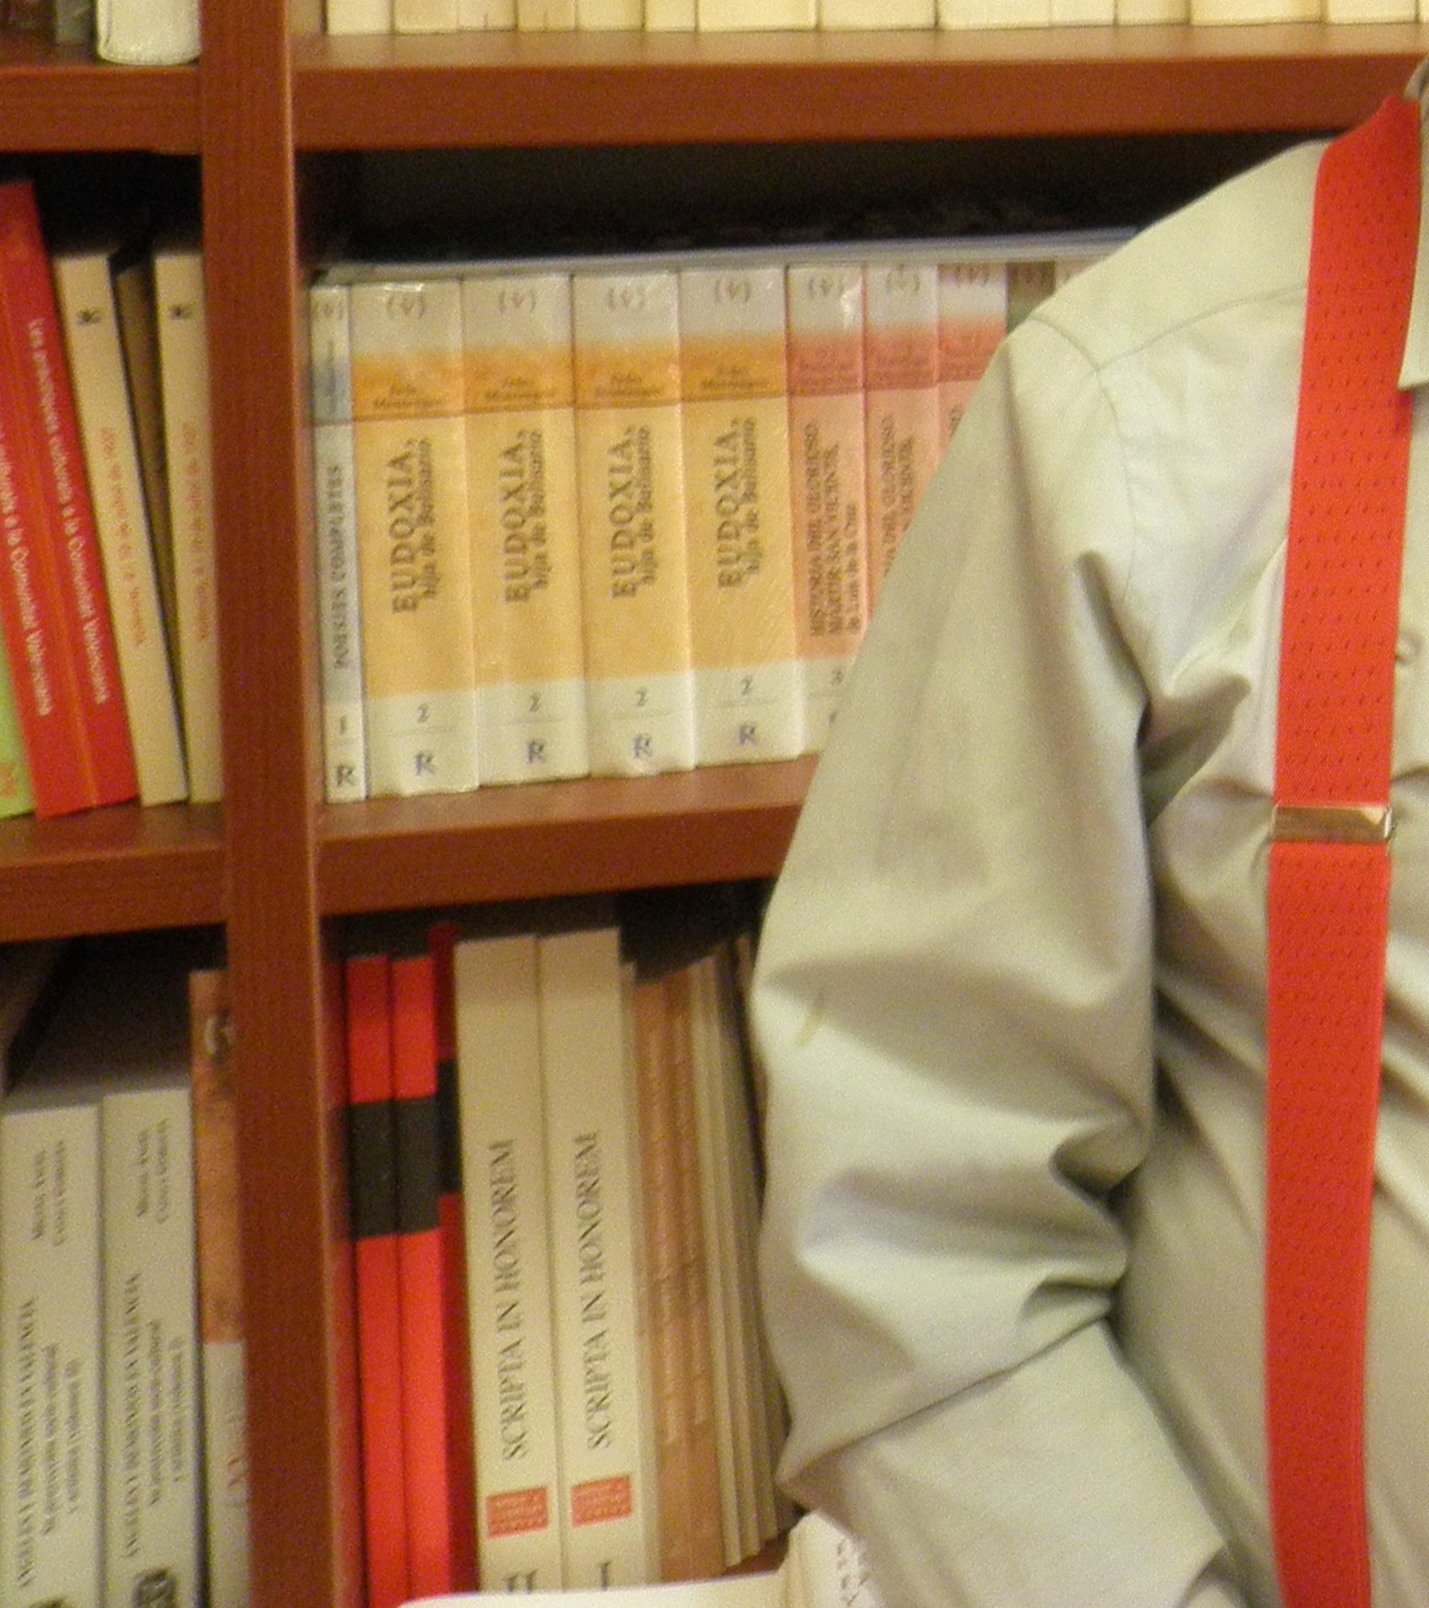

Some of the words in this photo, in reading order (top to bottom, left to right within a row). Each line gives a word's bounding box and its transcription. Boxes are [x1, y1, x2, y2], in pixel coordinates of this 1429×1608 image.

[26, 318, 46, 349] Les
[526, 427, 547, 518] Belisario
[634, 425, 655, 514] Belisario
[739, 417, 760, 503] Belisario
[415, 437, 436, 527] Belisario
[496, 430, 530, 604] EUDOXIA,
[607, 425, 639, 601] EUDOXIA,
[713, 417, 743, 590] EUDOXIA,
[739, 510, 760, 534] de
[327, 465, 347, 583] COMPLETES
[386, 438, 420, 615] EUDOXIA,
[526, 524, 547, 548] de
[634, 519, 655, 545] de
[805, 521, 822, 553] DEL
[880, 509, 896, 546] DEL
[414, 532, 434, 558] de
[741, 539, 765, 577] hija
[823, 529, 842, 566] SAN
[66, 535, 97, 618] Comunitat
[417, 563, 441, 601] hija
[528, 553, 552, 591] hija
[636, 548, 659, 587] hija
[11, 545, 42, 630] Comunitat
[808, 555, 827, 638] HISTORIA
[332, 589, 351, 670] POESIES
[25, 628, 55, 717] Valenciana
[81, 617, 110, 705] Valenciana
[528, 692, 542, 712] 2
[635, 687, 649, 707] 2
[740, 677, 753, 696] 2
[417, 703, 431, 723] 2
[527, 740, 547, 764] R
[633, 734, 654, 758] R
[738, 725, 758, 748] R
[335, 764, 357, 788] R
[414, 752, 436, 777] R
[487, 1138, 520, 1295] HONOREM
[574, 1132, 604, 1284] HONOREM
[121, 1272, 141, 1355] VALENCIA
[495, 1300, 522, 1333] IN
[580, 1290, 606, 1324] IN
[16, 1300, 36, 1383] VALENCIA
[497, 1339, 530, 1462] SCRIPTA
[582, 1332, 613, 1450] SCRIPTA
